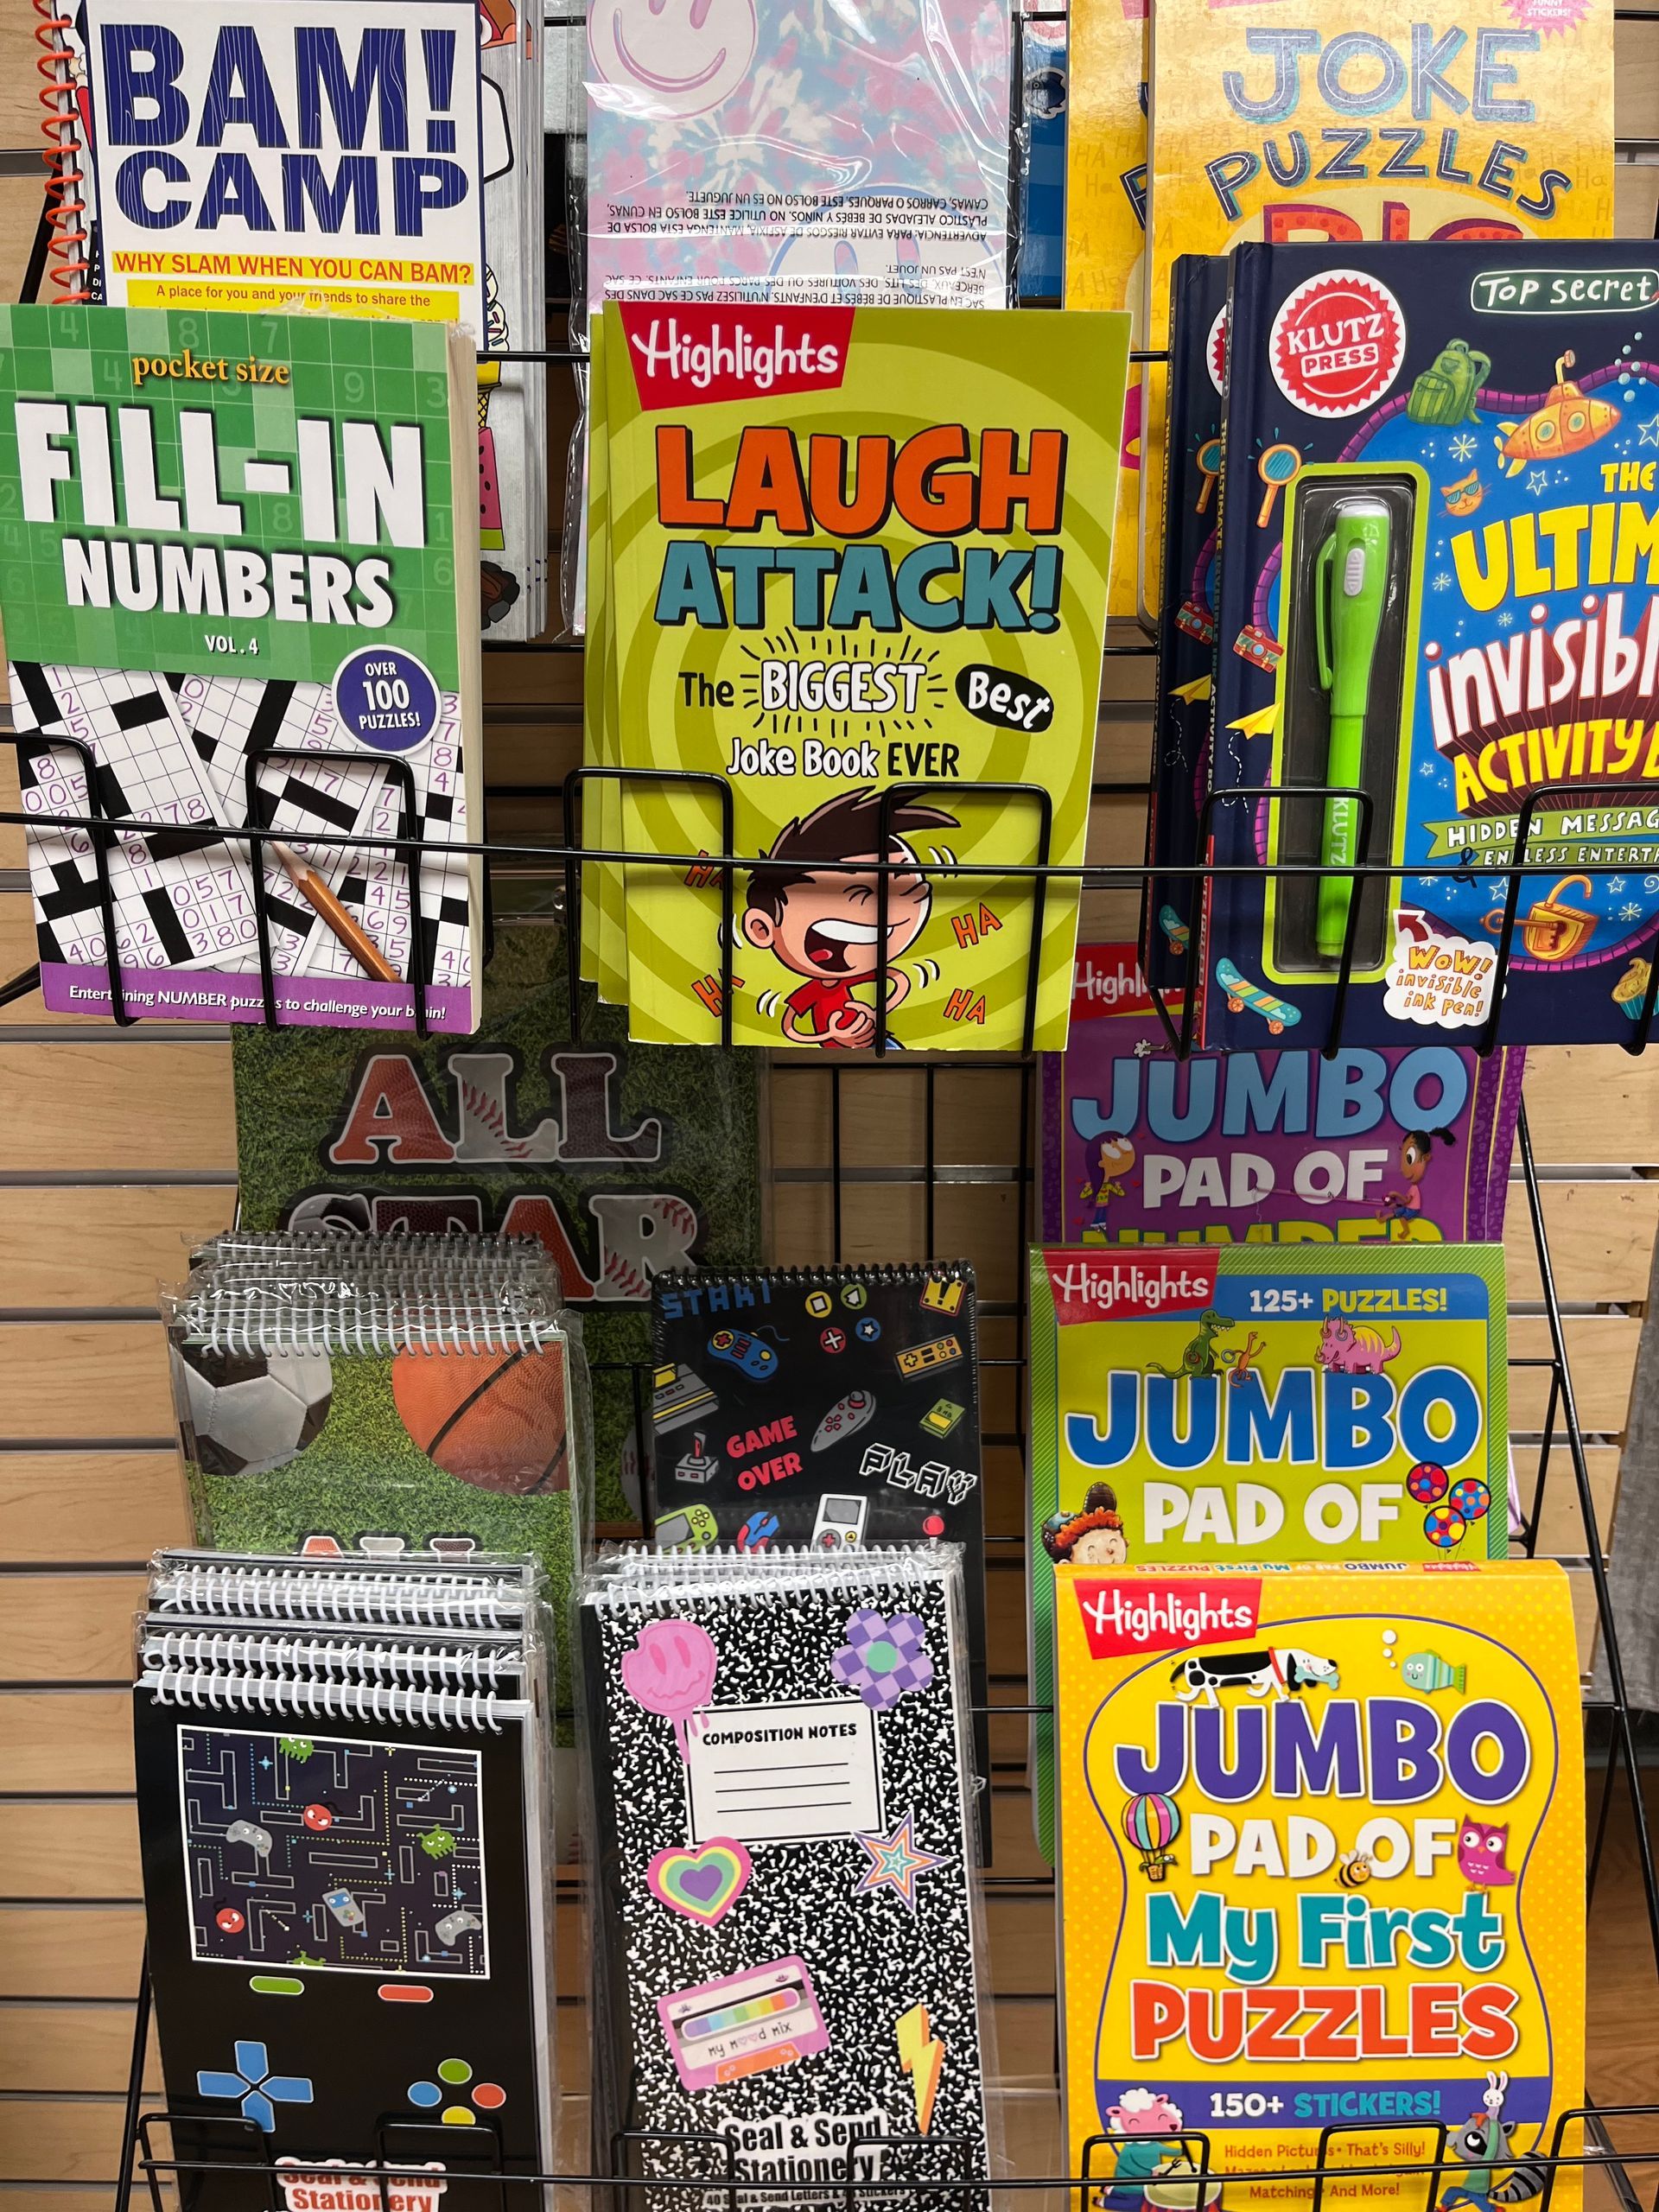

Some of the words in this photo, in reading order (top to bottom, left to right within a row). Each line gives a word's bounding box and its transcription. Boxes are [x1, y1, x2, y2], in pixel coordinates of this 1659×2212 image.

[1222, 22, 1541, 126] JOKE
[100, 23, 457, 154] BAM!
[1204, 127, 1573, 222] PUZZLES
[115, 149, 469, 238] CAMP
[685, 191, 734, 203] JUGUETE.
[735, 193, 750, 204] UN
[753, 194, 765, 205] ES
[766, 194, 782, 205] NO
[785, 194, 819, 207] BOLSO
[821, 196, 844, 207] ESTE
[896, 197, 905, 208] O
[606, 203, 645, 218] CUNAS,
[906, 198, 947, 209] CARROS
[949, 196, 988, 210] CAMAS,
[648, 207, 662, 219] EN
[665, 208, 699, 219] BOLSO
[702, 209, 726, 219] ESTE
[729, 209, 766, 220] UTILICE
[769, 211, 785, 220] NO
[789, 211, 823, 224] NIÑOS.
[826, 213, 833, 222] Y
[836, 213, 866, 225] BEBÉS
[868, 213, 882, 224] DE
[886, 213, 937, 225] ALEJADAS
[939, 214, 988, 228] PLÁSTICO
[607, 222, 621, 232] DE
[624, 223, 657, 232] BOLSA
[661, 224, 683, 232] ESTA
[806, 227, 848, 238] RIESGOS
[850, 229, 884, 238] EVITAR
[887, 229, 912, 239] PARA
[116, 252, 166, 273] WHY
[172, 254, 232, 275] SLAM
[238, 255, 303, 278] WHEN
[309, 258, 353, 278] YOU
[359, 260, 404, 282] CAN
[410, 263, 472, 284] BAM?
[885, 264, 919, 275] JOUET.
[921, 265, 937, 275] UN
[938, 266, 957, 276] PAS
[156, 284, 165, 296] A
[169, 285, 203, 300] place
[206, 286, 223, 298] for
[226, 289, 249, 302] you
[251, 288, 276, 301] and
[279, 291, 306, 304] your
[356, 292, 368, 304] to
[372, 292, 407, 306] share
[410, 295, 431, 307] the
[605, 289, 625, 300] DES
[626, 289, 656, 300] DANS
[658, 290, 678, 301] SAC
[680, 290, 694, 302] CE
[695, 290, 714, 302] PAS
[715, 291, 769, 303] N'UTILISEZ
[772, 291, 828, 303] D'ENFANTS.
[830, 293, 842, 303] ET
[844, 293, 874, 306] BÉBÉS
[878, 294, 891, 304] DE
[893, 292, 948, 304] PLASTIQUE
[1287, 313, 1386, 357] KLUTZ
[632, 318, 839, 389] Highlights
[1305, 347, 1377, 372] PRESS
[132, 349, 229, 385] pocket
[235, 355, 290, 385] size
[15, 402, 426, 550] FILL-IN
[655, 423, 1069, 538] LAUGH
[1601, 461, 1657, 493] THE
[1217, 461, 1226, 550] ULTIMATE
[61, 537, 396, 629] NUMBERS
[653, 541, 1065, 635] ATTACK!
[248, 638, 259, 656] 4
[365, 662, 397, 677] OVER
[362, 678, 410, 711] 100
[678, 671, 734, 708] The
[761, 660, 928, 713] BIGGEST
[965, 670, 1053, 730] Best
[359, 712, 422, 731] PUZZLES!
[1208, 683, 1217, 764] ACTIVITY
[727, 738, 797, 777] Joke
[802, 739, 879, 779] Book
[887, 743, 960, 777] EVER
[1452, 718, 1645, 814] ACTIVITY
[1331, 797, 1350, 866] KLUTZ
[1446, 817, 1543, 849] HIDDEN
[951, 903, 1003, 950] HA
[1396, 969, 1482, 1000] invisible
[69, 985, 156, 1007] Entertining
[157, 990, 227, 1007] NUMBER
[285, 999, 301, 1010] to
[303, 999, 368, 1018] challenge
[371, 1005, 404, 1020] your
[944, 988, 985, 1024] HA
[1404, 990, 1436, 1012] ink
[1441, 993, 1484, 1018] pen!
[1071, 1046, 1468, 1143] JUMBO
[328, 1053, 662, 1165] ALL
[1142, 1152, 1275, 1210] PAD
[1293, 1149, 1389, 1205] OF
[1052, 1262, 1210, 1310] Highlights
[1249, 1288, 1314, 1313] 125+
[1321, 1288, 1448, 1313] PUZZLES!
[1065, 1364, 1483, 1471] JUMBO
[726, 1414, 798, 1459] GAME
[737, 1452, 804, 1491] OVER
[859, 1442, 978, 1506] PLAY
[1142, 1480, 1285, 1547] PAD
[1302, 1482, 1404, 1543] OF
[1082, 1588, 1255, 1642] Highlights
[702, 1726, 804, 1747] COMPOSITION
[808, 1723, 858, 1741] NOTES
[1113, 1696, 1533, 1805] JUMBO
[1189, 1812, 1338, 1879] PAD
[1355, 1817, 1458, 1878] OF
[1146, 1890, 1281, 1986] My
[1297, 1889, 1505, 1974] First
[1130, 1980, 1520, 2064] PUZZLES
[1210, 2092, 1285, 2118] 150+
[1294, 2089, 1441, 2118] STICKERS!
[725, 2120, 785, 2152] Seal
[790, 2124, 808, 2149] &
[814, 2114, 882, 2147] Send
[1224, 2144, 1273, 2158] Hidden
[1276, 2144, 1334, 2158] Picturs
[1346, 2143, 1389, 2157] That's
[1393, 2142, 1426, 2158] Silly!
[761, 2191, 789, 2203] Send
[791, 2190, 830, 2202] Letters
[1249, 2184, 1315, 2200] Matching
[1329, 2184, 1357, 2198] And
[1360, 2182, 1400, 2196] More!
